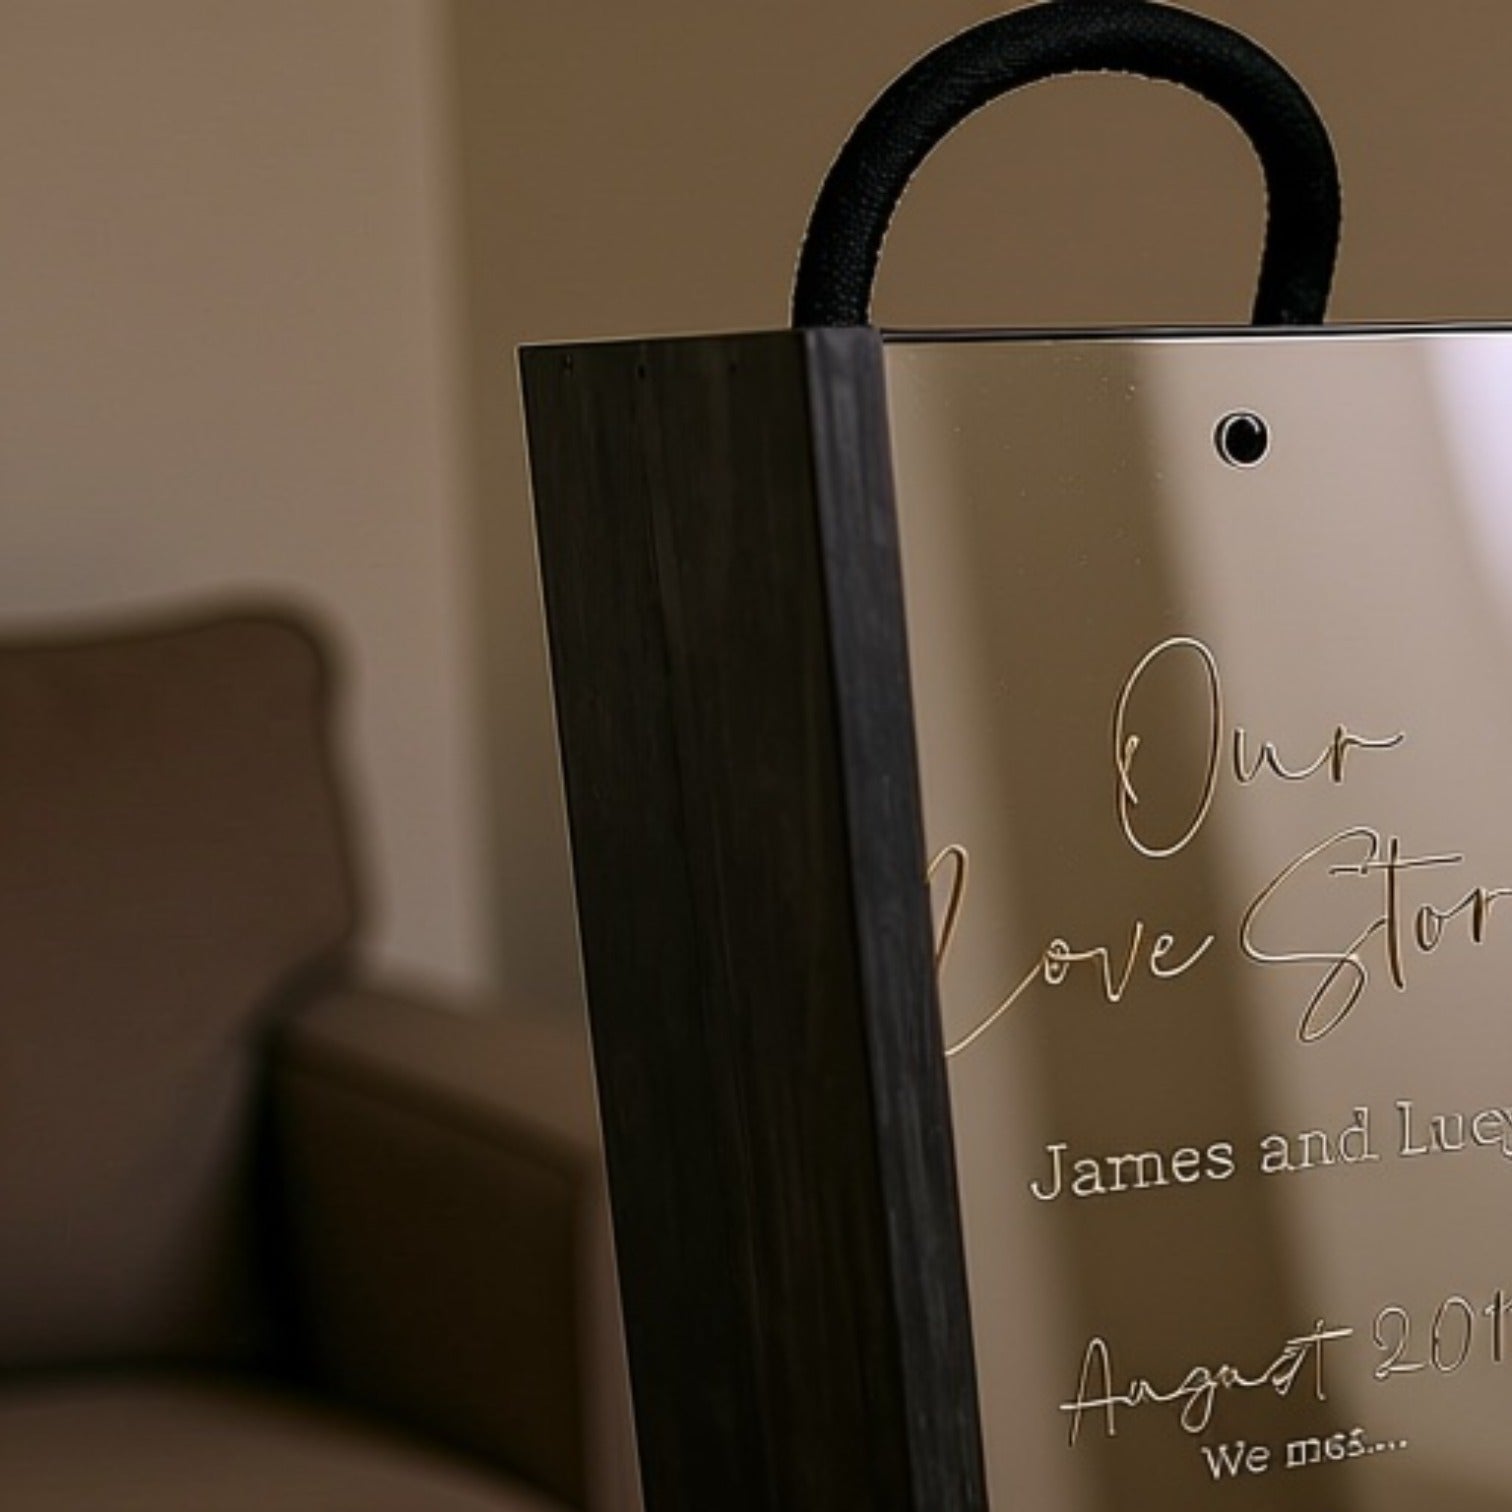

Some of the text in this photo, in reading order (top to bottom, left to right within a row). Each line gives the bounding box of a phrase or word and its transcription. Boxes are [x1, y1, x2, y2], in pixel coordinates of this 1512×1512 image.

[1113, 636, 1405, 858] Our
[1029, 1142, 1236, 1201] James
[1259, 1105, 1381, 1174] and
[1201, 1440, 1271, 1481] We
